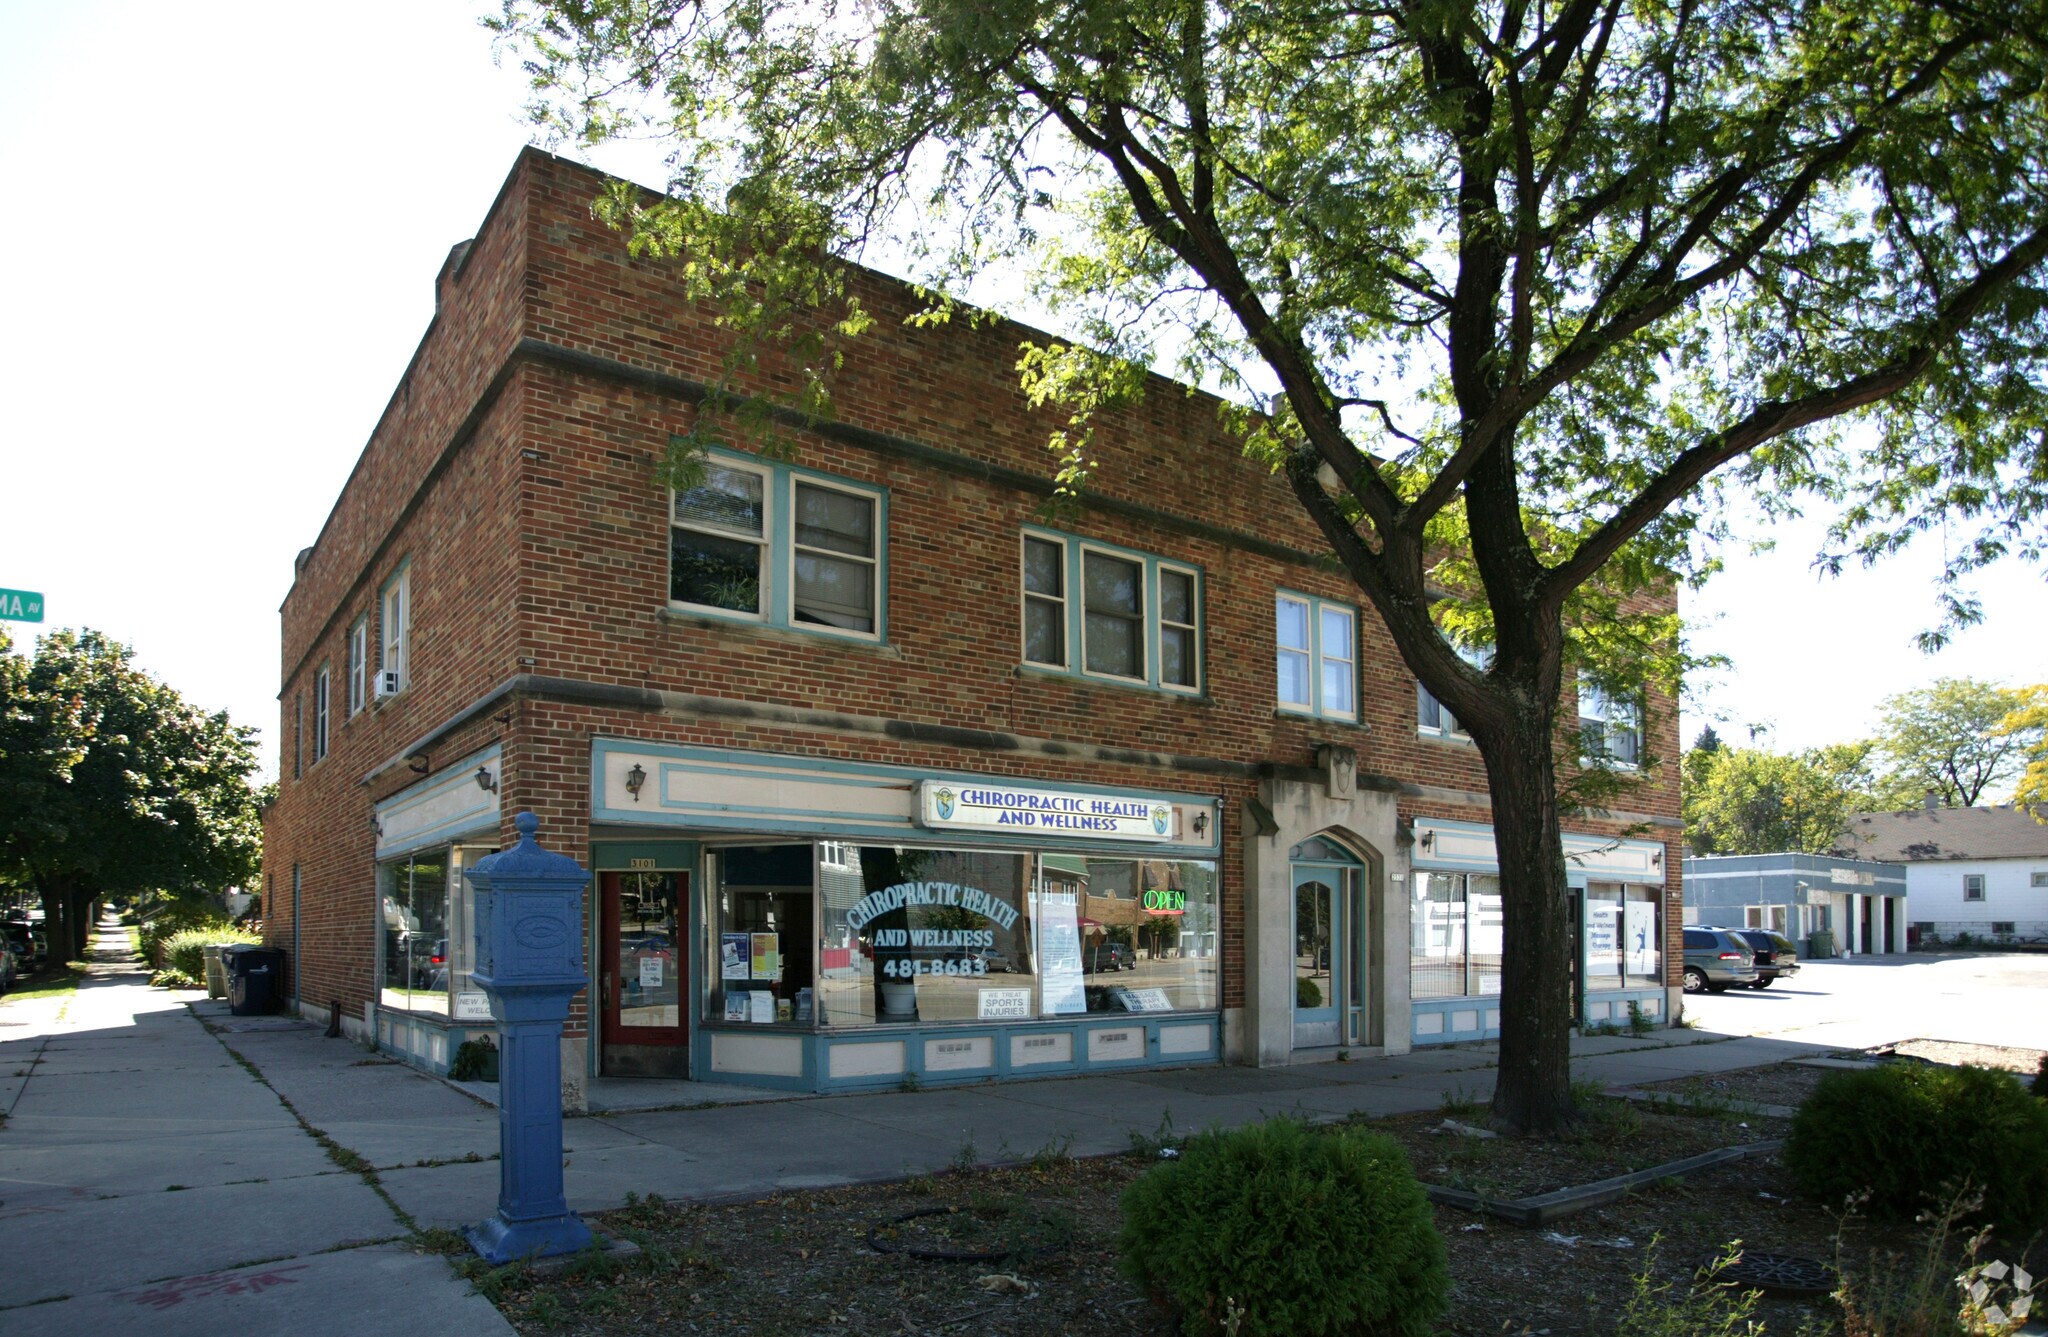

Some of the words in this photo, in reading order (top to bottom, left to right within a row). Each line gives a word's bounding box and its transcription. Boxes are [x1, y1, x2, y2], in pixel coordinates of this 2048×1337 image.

[28, 602, 40, 613] AV
[961, 789, 1085, 812] CHIROPRACTIC
[1091, 800, 1148, 817] HEALTH
[997, 810, 1036, 826] AND
[1041, 814, 1118, 831] WELLNESS
[632, 859, 654, 868] 3101
[846, 881, 960, 930] CHIROPRACTIC
[961, 887, 1019, 931] HEALTH
[1144, 890, 1185, 910] OPEN
[874, 929, 907, 947] AND
[909, 929, 993, 947] WELLNESS
[883, 959, 986, 978] 481-8683
[983, 1007, 1025, 1016] INJURIES
[985, 998, 1024, 1007] SPORTS
